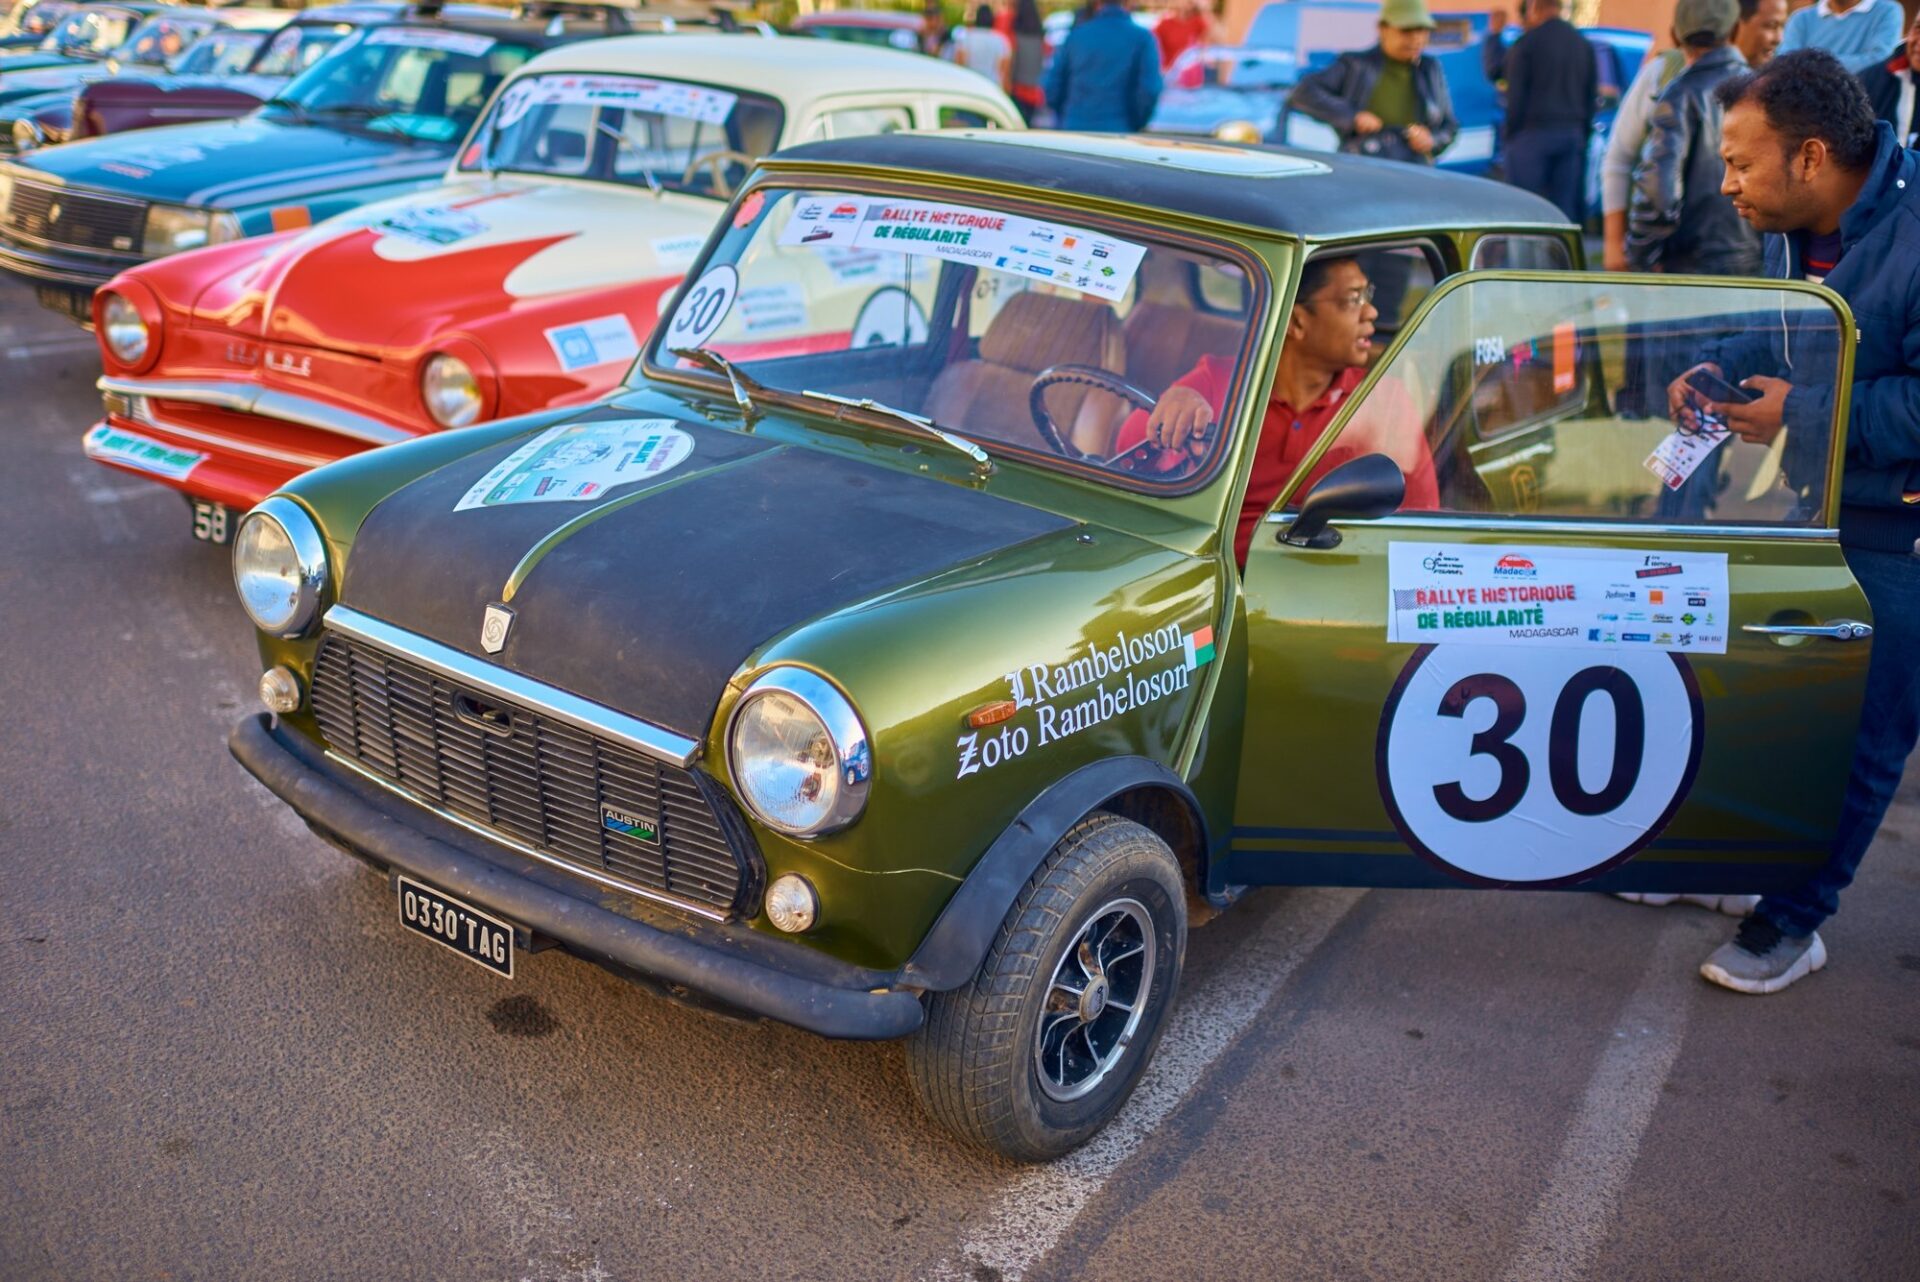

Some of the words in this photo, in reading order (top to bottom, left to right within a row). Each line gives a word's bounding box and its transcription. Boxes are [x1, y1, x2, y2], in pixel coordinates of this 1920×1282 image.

[881, 207, 927, 223] RALLYE
[929, 209, 1007, 231] HISTORIQUE
[873, 225, 889, 238] DE
[893, 221, 972, 245] RÉGULARITÉ
[935, 245, 993, 260] MADAGASCAR
[675, 285, 727, 336] 30
[1416, 587, 1477, 606] RALLYE
[1481, 584, 1577, 604] HISTORIQUE
[1417, 611, 1438, 630] DE
[1443, 602, 1544, 629] RÉGULARITÉ
[1509, 627, 1579, 639] MADAGASCAR
[1027, 622, 1185, 704] Rambeloson
[956, 722, 1029, 780] Zoto
[1035, 663, 1189, 748] Rambeloson
[1432, 664, 1645, 824] 30
[605, 809, 655, 833] AUSTIN
[404, 890, 458, 942] 0330
[465, 915, 506, 965] TAG
